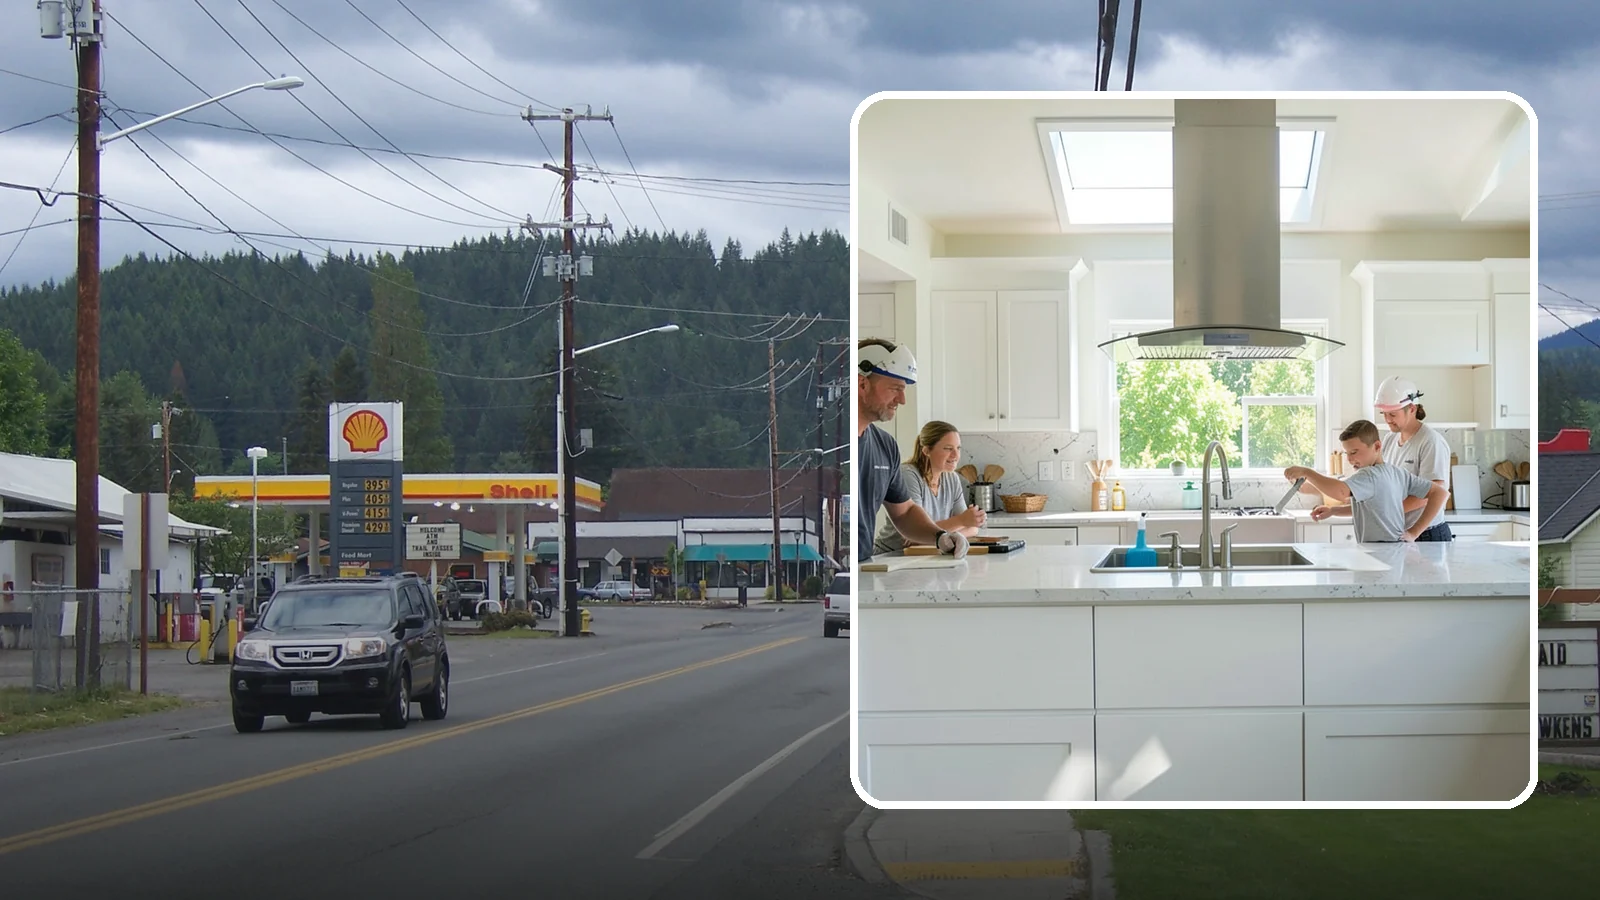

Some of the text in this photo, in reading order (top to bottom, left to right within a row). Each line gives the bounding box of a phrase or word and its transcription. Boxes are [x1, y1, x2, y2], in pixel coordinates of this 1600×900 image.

[366, 480, 383, 490] 395
[490, 484, 547, 498] Shell
[366, 494, 383, 504] 405
[366, 508, 383, 518] 415
[366, 522, 383, 532] 429
[1538, 643, 1566, 666] AID
